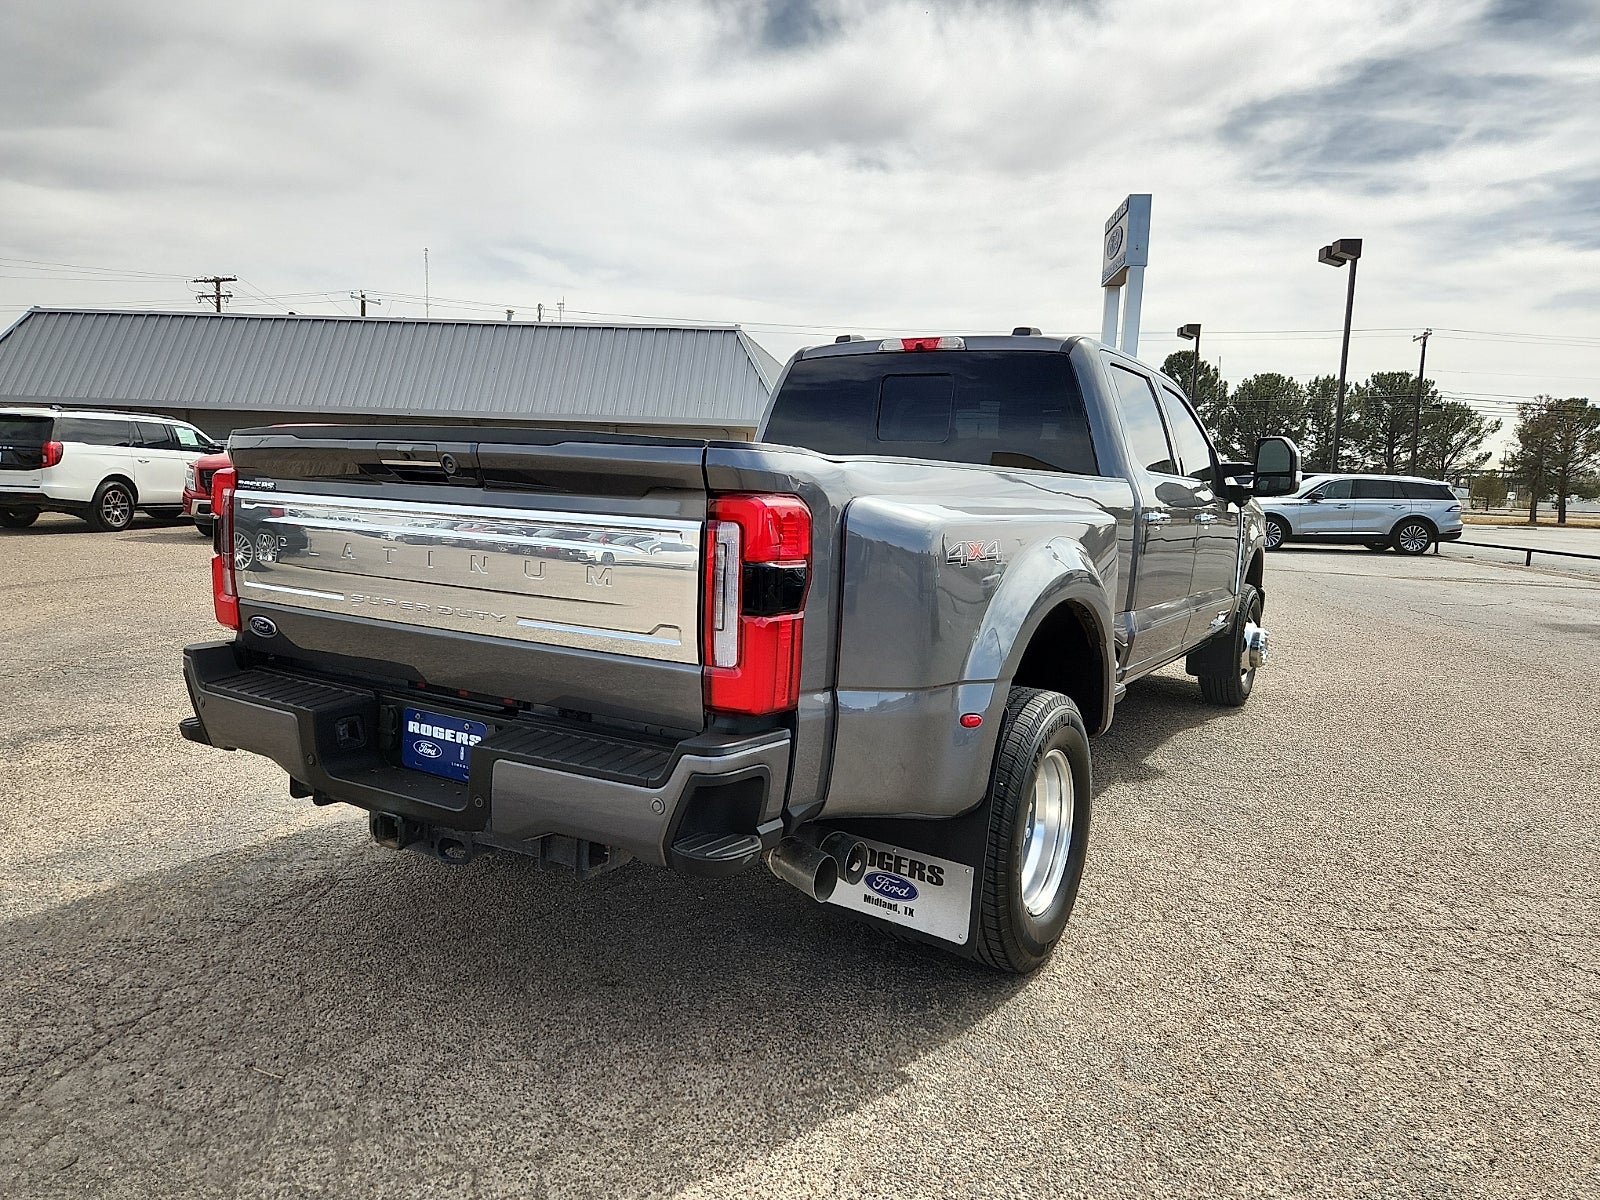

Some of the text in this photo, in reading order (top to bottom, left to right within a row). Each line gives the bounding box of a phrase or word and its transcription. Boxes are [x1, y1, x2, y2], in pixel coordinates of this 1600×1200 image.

[276, 534, 613, 587] PLATINUM
[350, 593, 507, 623] SUPER DUTY
[408, 720, 482, 747] ROGERS
[872, 875, 910, 898] Ford
[863, 893, 915, 918] Midland, TX
